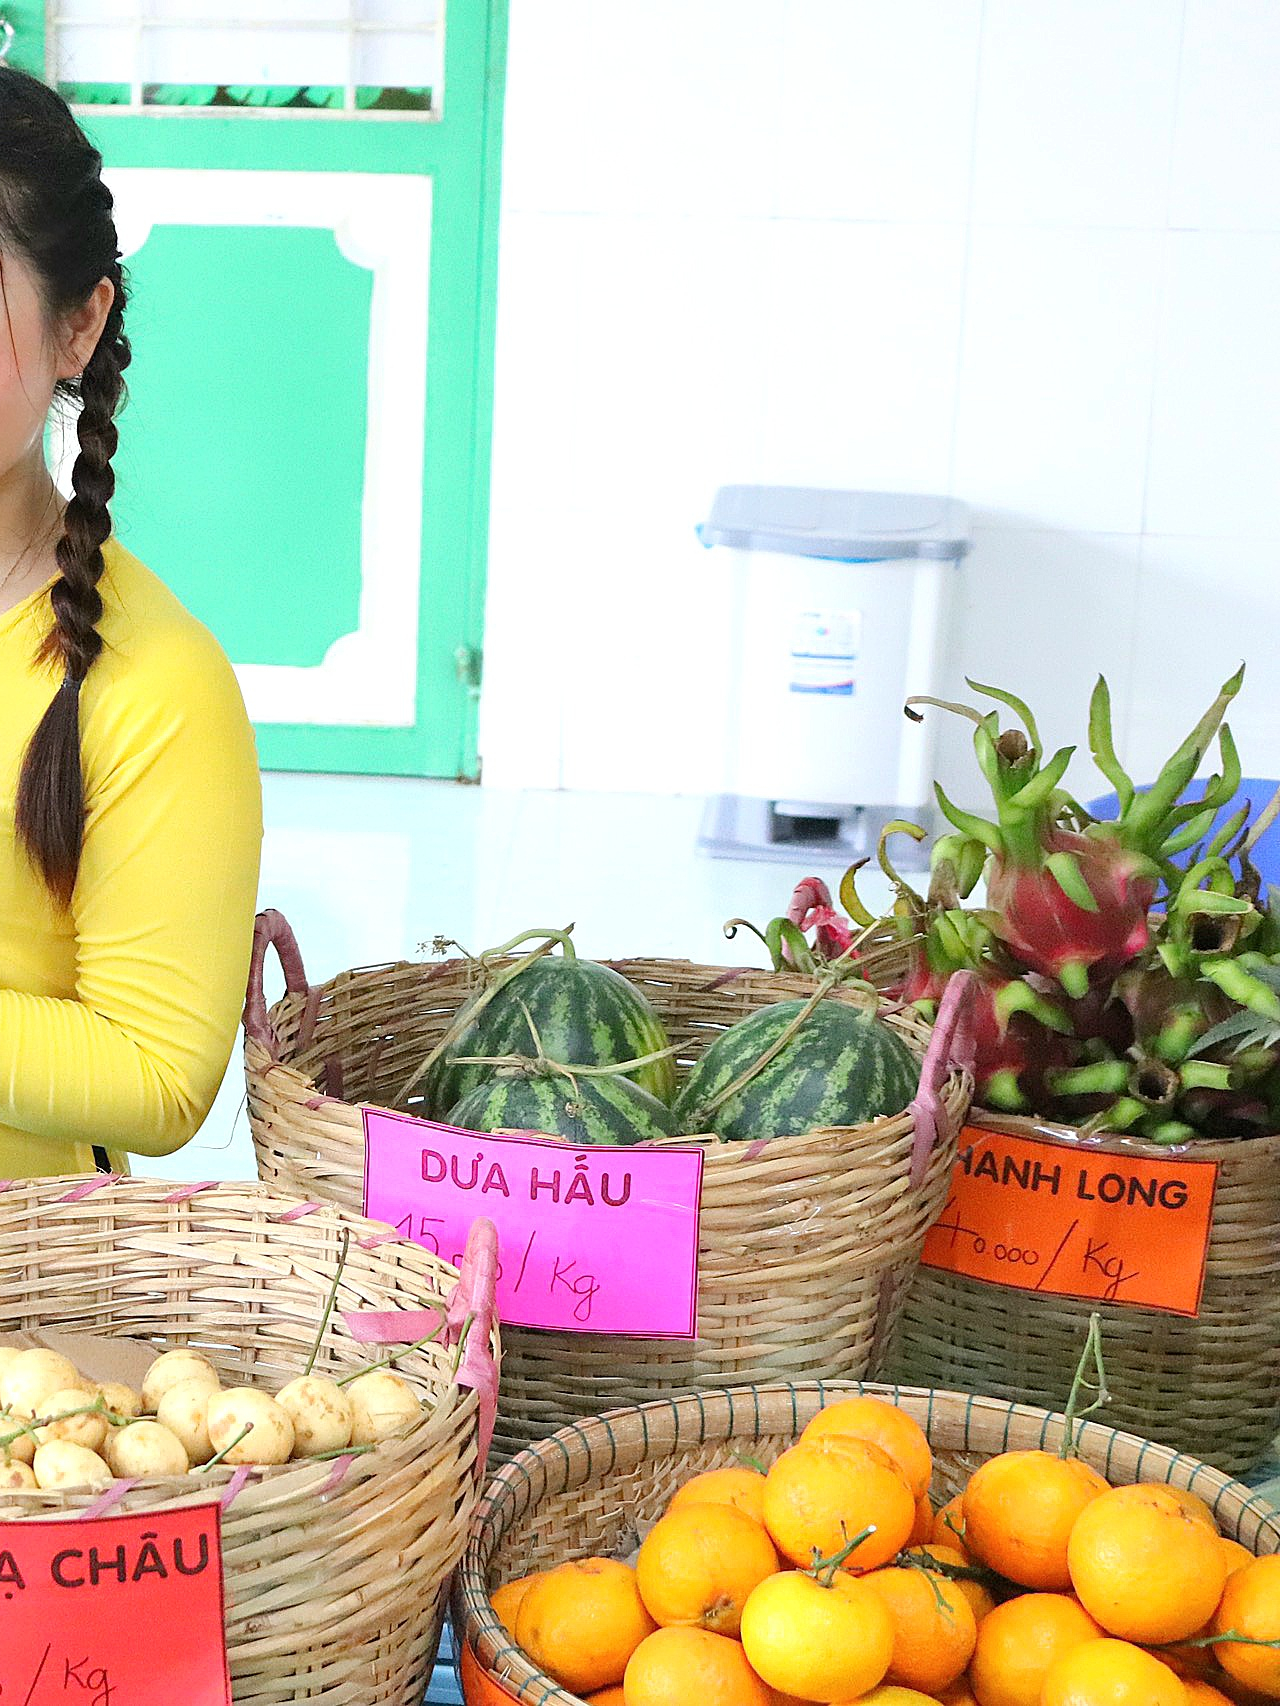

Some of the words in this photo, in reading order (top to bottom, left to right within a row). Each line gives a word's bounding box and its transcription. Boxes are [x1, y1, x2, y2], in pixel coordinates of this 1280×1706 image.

[422, 1149, 510, 1198] DƯA
[530, 1154, 632, 1207] HẤU
[1077, 1170, 1188, 1210] LONG
[51, 1531, 208, 1588] CHÂU
